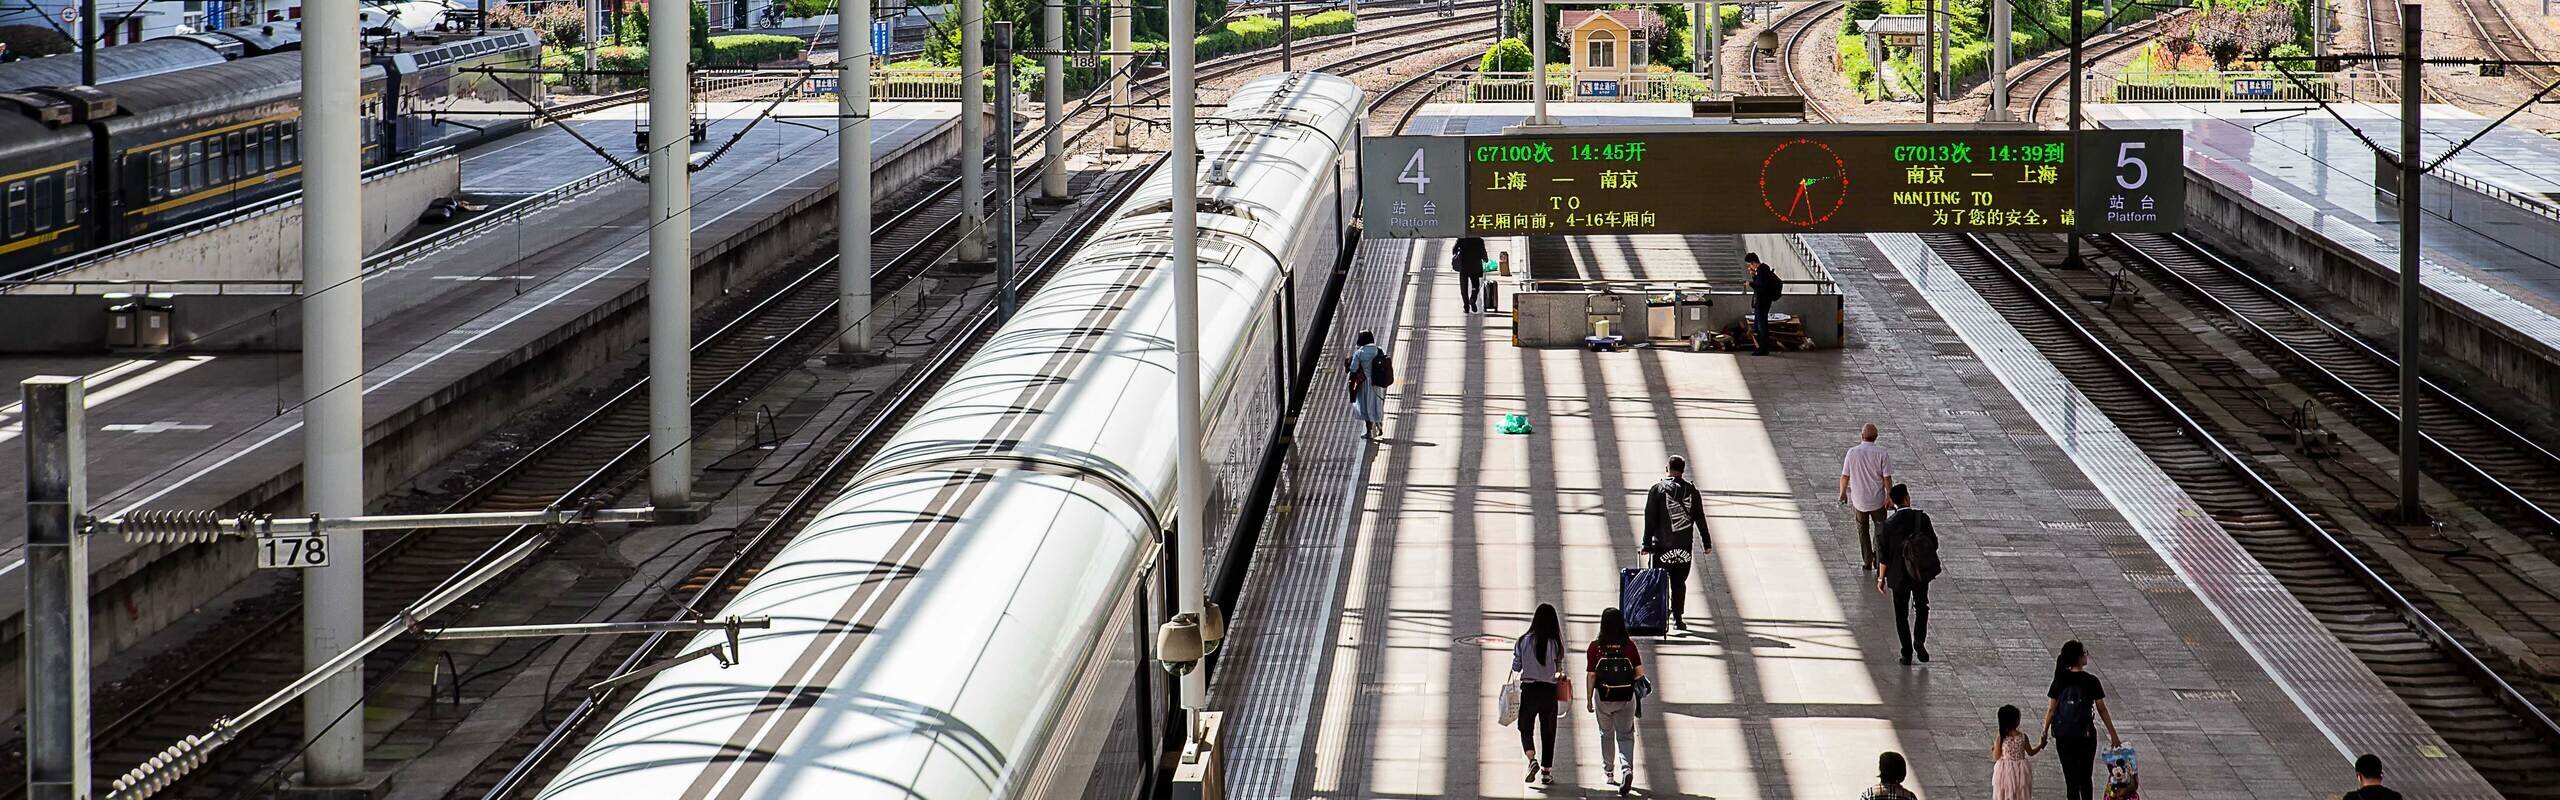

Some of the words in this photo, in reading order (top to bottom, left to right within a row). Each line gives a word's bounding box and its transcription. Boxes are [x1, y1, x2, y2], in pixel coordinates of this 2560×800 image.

[1074, 57, 1095, 67] 188
[2482, 66, 2504, 76] 245
[1594, 82, 1615, 90] 禁止通行
[1477, 142, 1554, 164] G7100次
[1571, 141, 1647, 163] 14:45开
[1894, 143, 1972, 163] G7013次
[1989, 143, 2065, 162] 14:39到
[1397, 148, 1430, 194] 4
[1906, 165, 1946, 185] 南京
[2017, 165, 2058, 185] 上海
[2116, 142, 2148, 190] 5
[1487, 170, 1528, 190] 上海
[1599, 170, 1639, 190] 南京
[1893, 191, 1961, 207] NANJING
[1971, 192, 1993, 207] TO
[2109, 194, 2155, 210] 站台
[1390, 217, 1439, 227] Platform
[2107, 211, 2157, 222] Platform
[265, 538, 326, 566] 178
